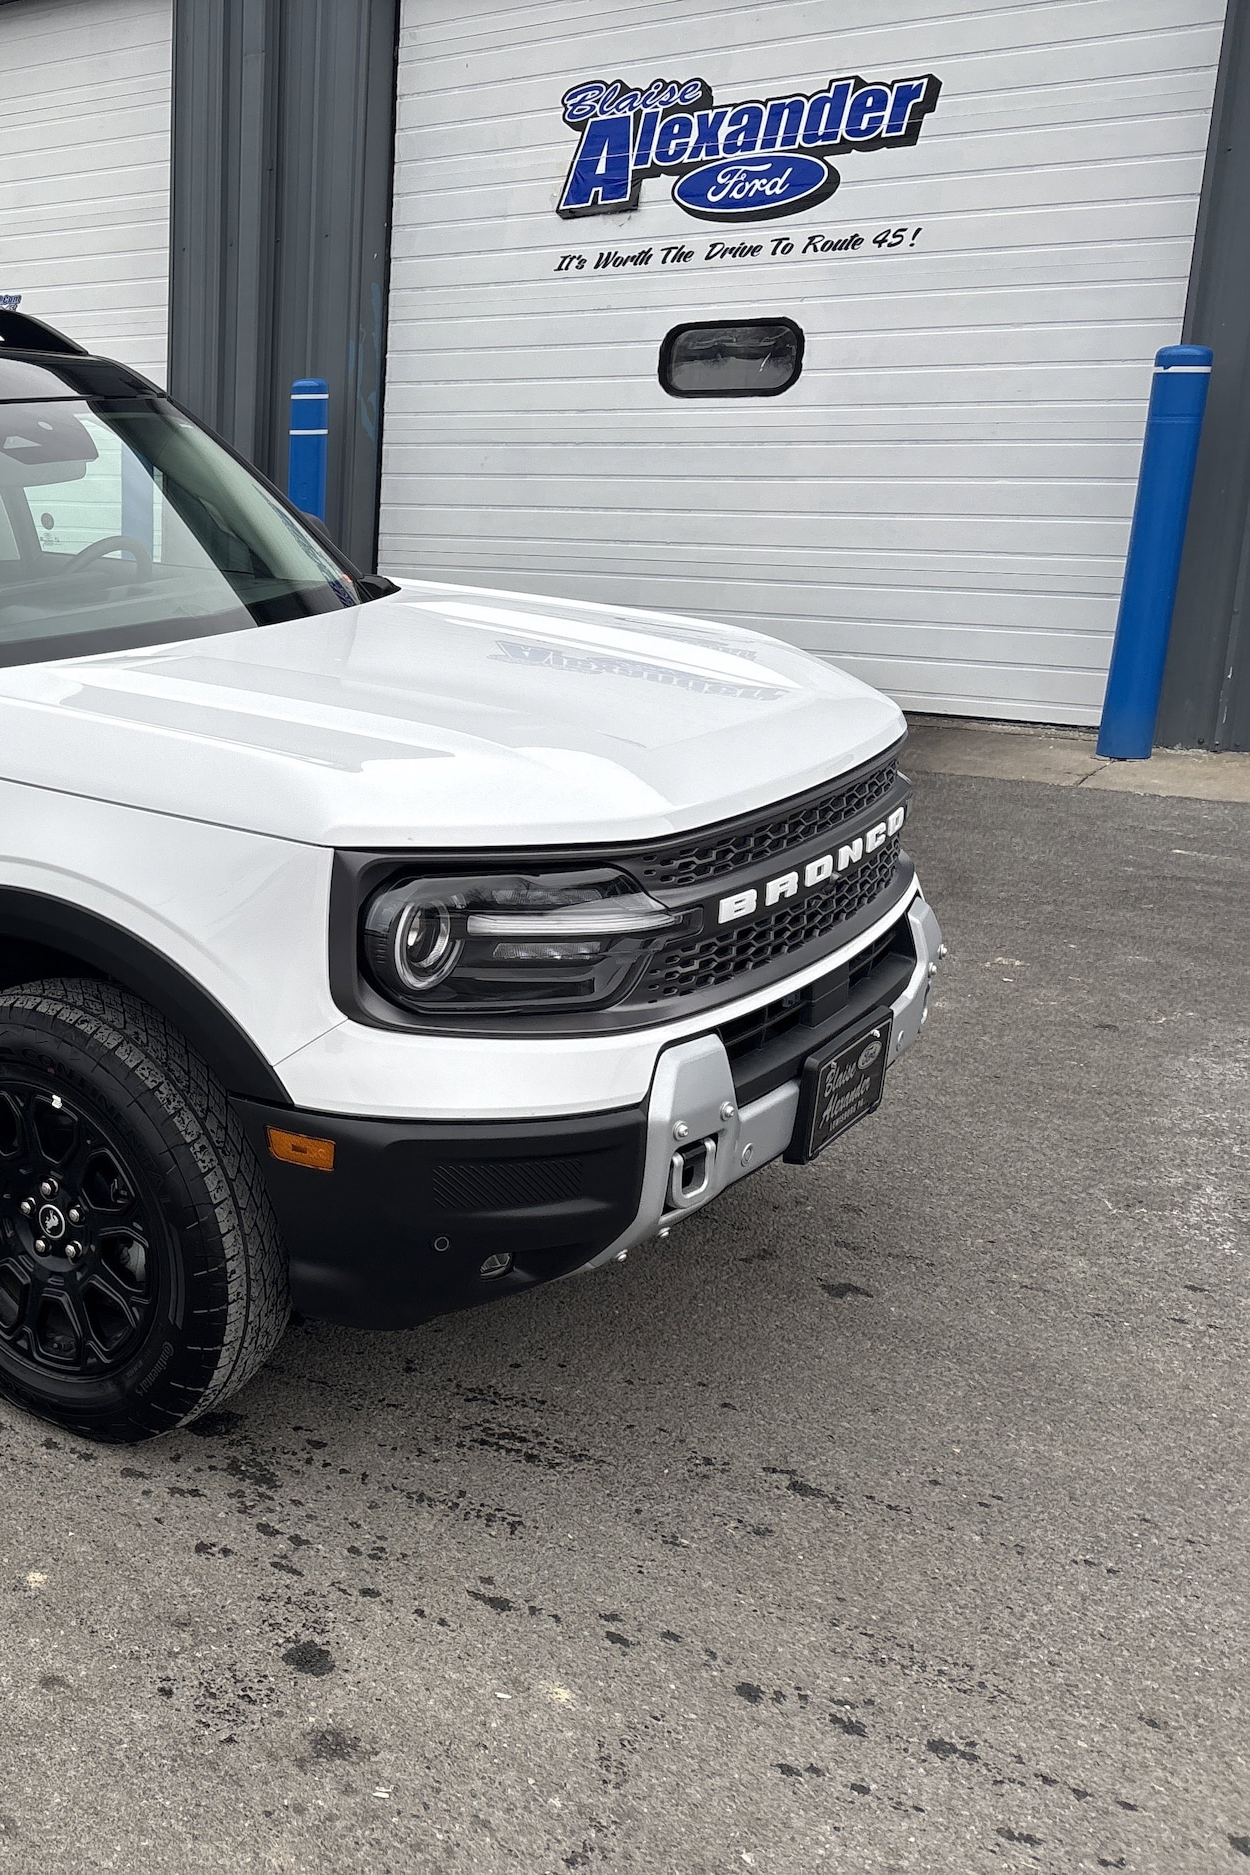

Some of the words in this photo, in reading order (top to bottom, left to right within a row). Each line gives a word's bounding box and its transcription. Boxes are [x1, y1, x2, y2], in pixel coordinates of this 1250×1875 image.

[562, 79, 705, 123] Blaise
[558, 76, 934, 212] Alexander
[706, 162, 791, 203] Ford
[553, 254, 588, 272] It's
[593, 247, 654, 270] Worth
[660, 244, 695, 265] The
[704, 242, 764, 261] Drive
[770, 237, 795, 256] To
[801, 233, 866, 254] Route
[717, 806, 905, 924] BRONCO
[818, 1073, 871, 1129] Alexander
[824, 1061, 857, 1098] Blaise
[138, 1340, 175, 1394] Continental
